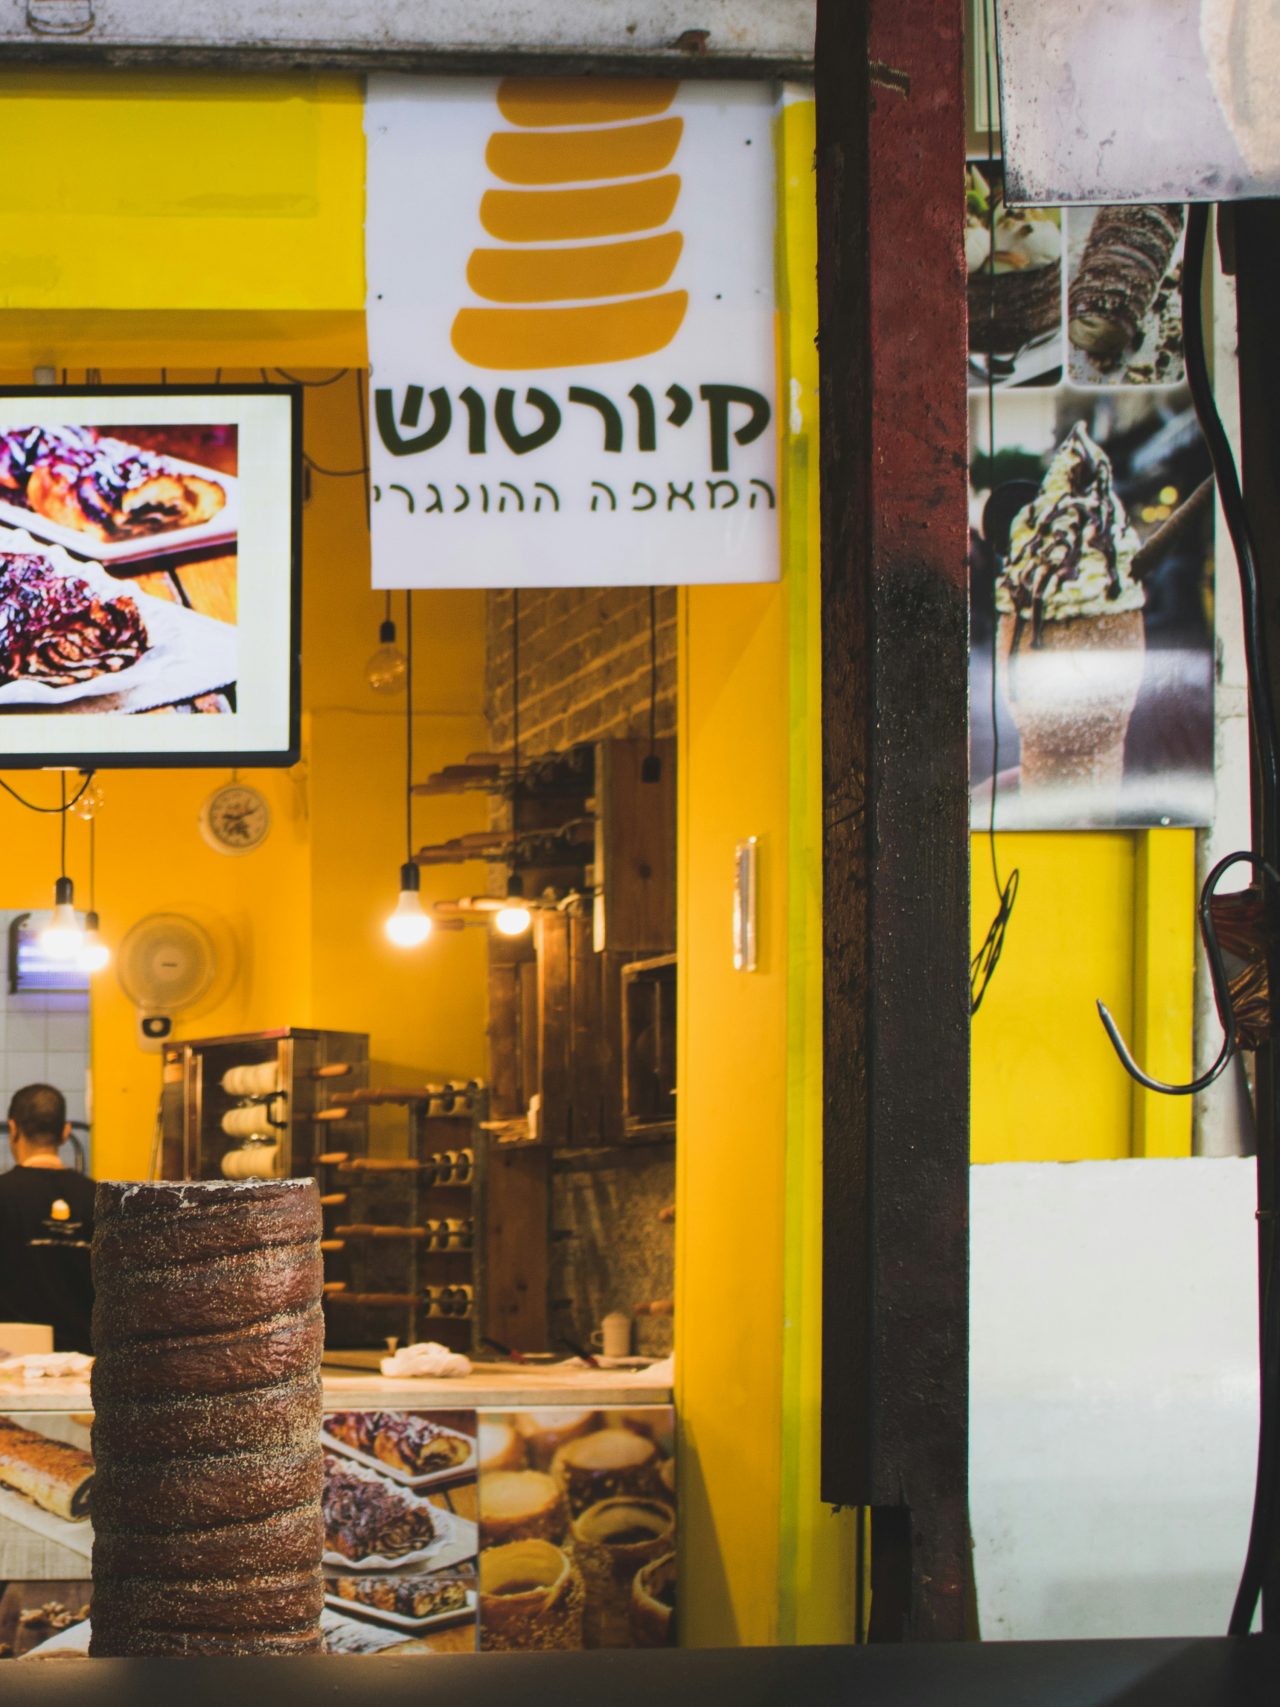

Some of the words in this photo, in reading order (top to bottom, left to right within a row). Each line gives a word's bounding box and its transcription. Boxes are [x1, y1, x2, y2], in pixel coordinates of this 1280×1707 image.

[375, 384, 772, 472] קיורטוש
[373, 481, 561, 512] ההונגרי
[590, 479, 777, 511] המאפה
